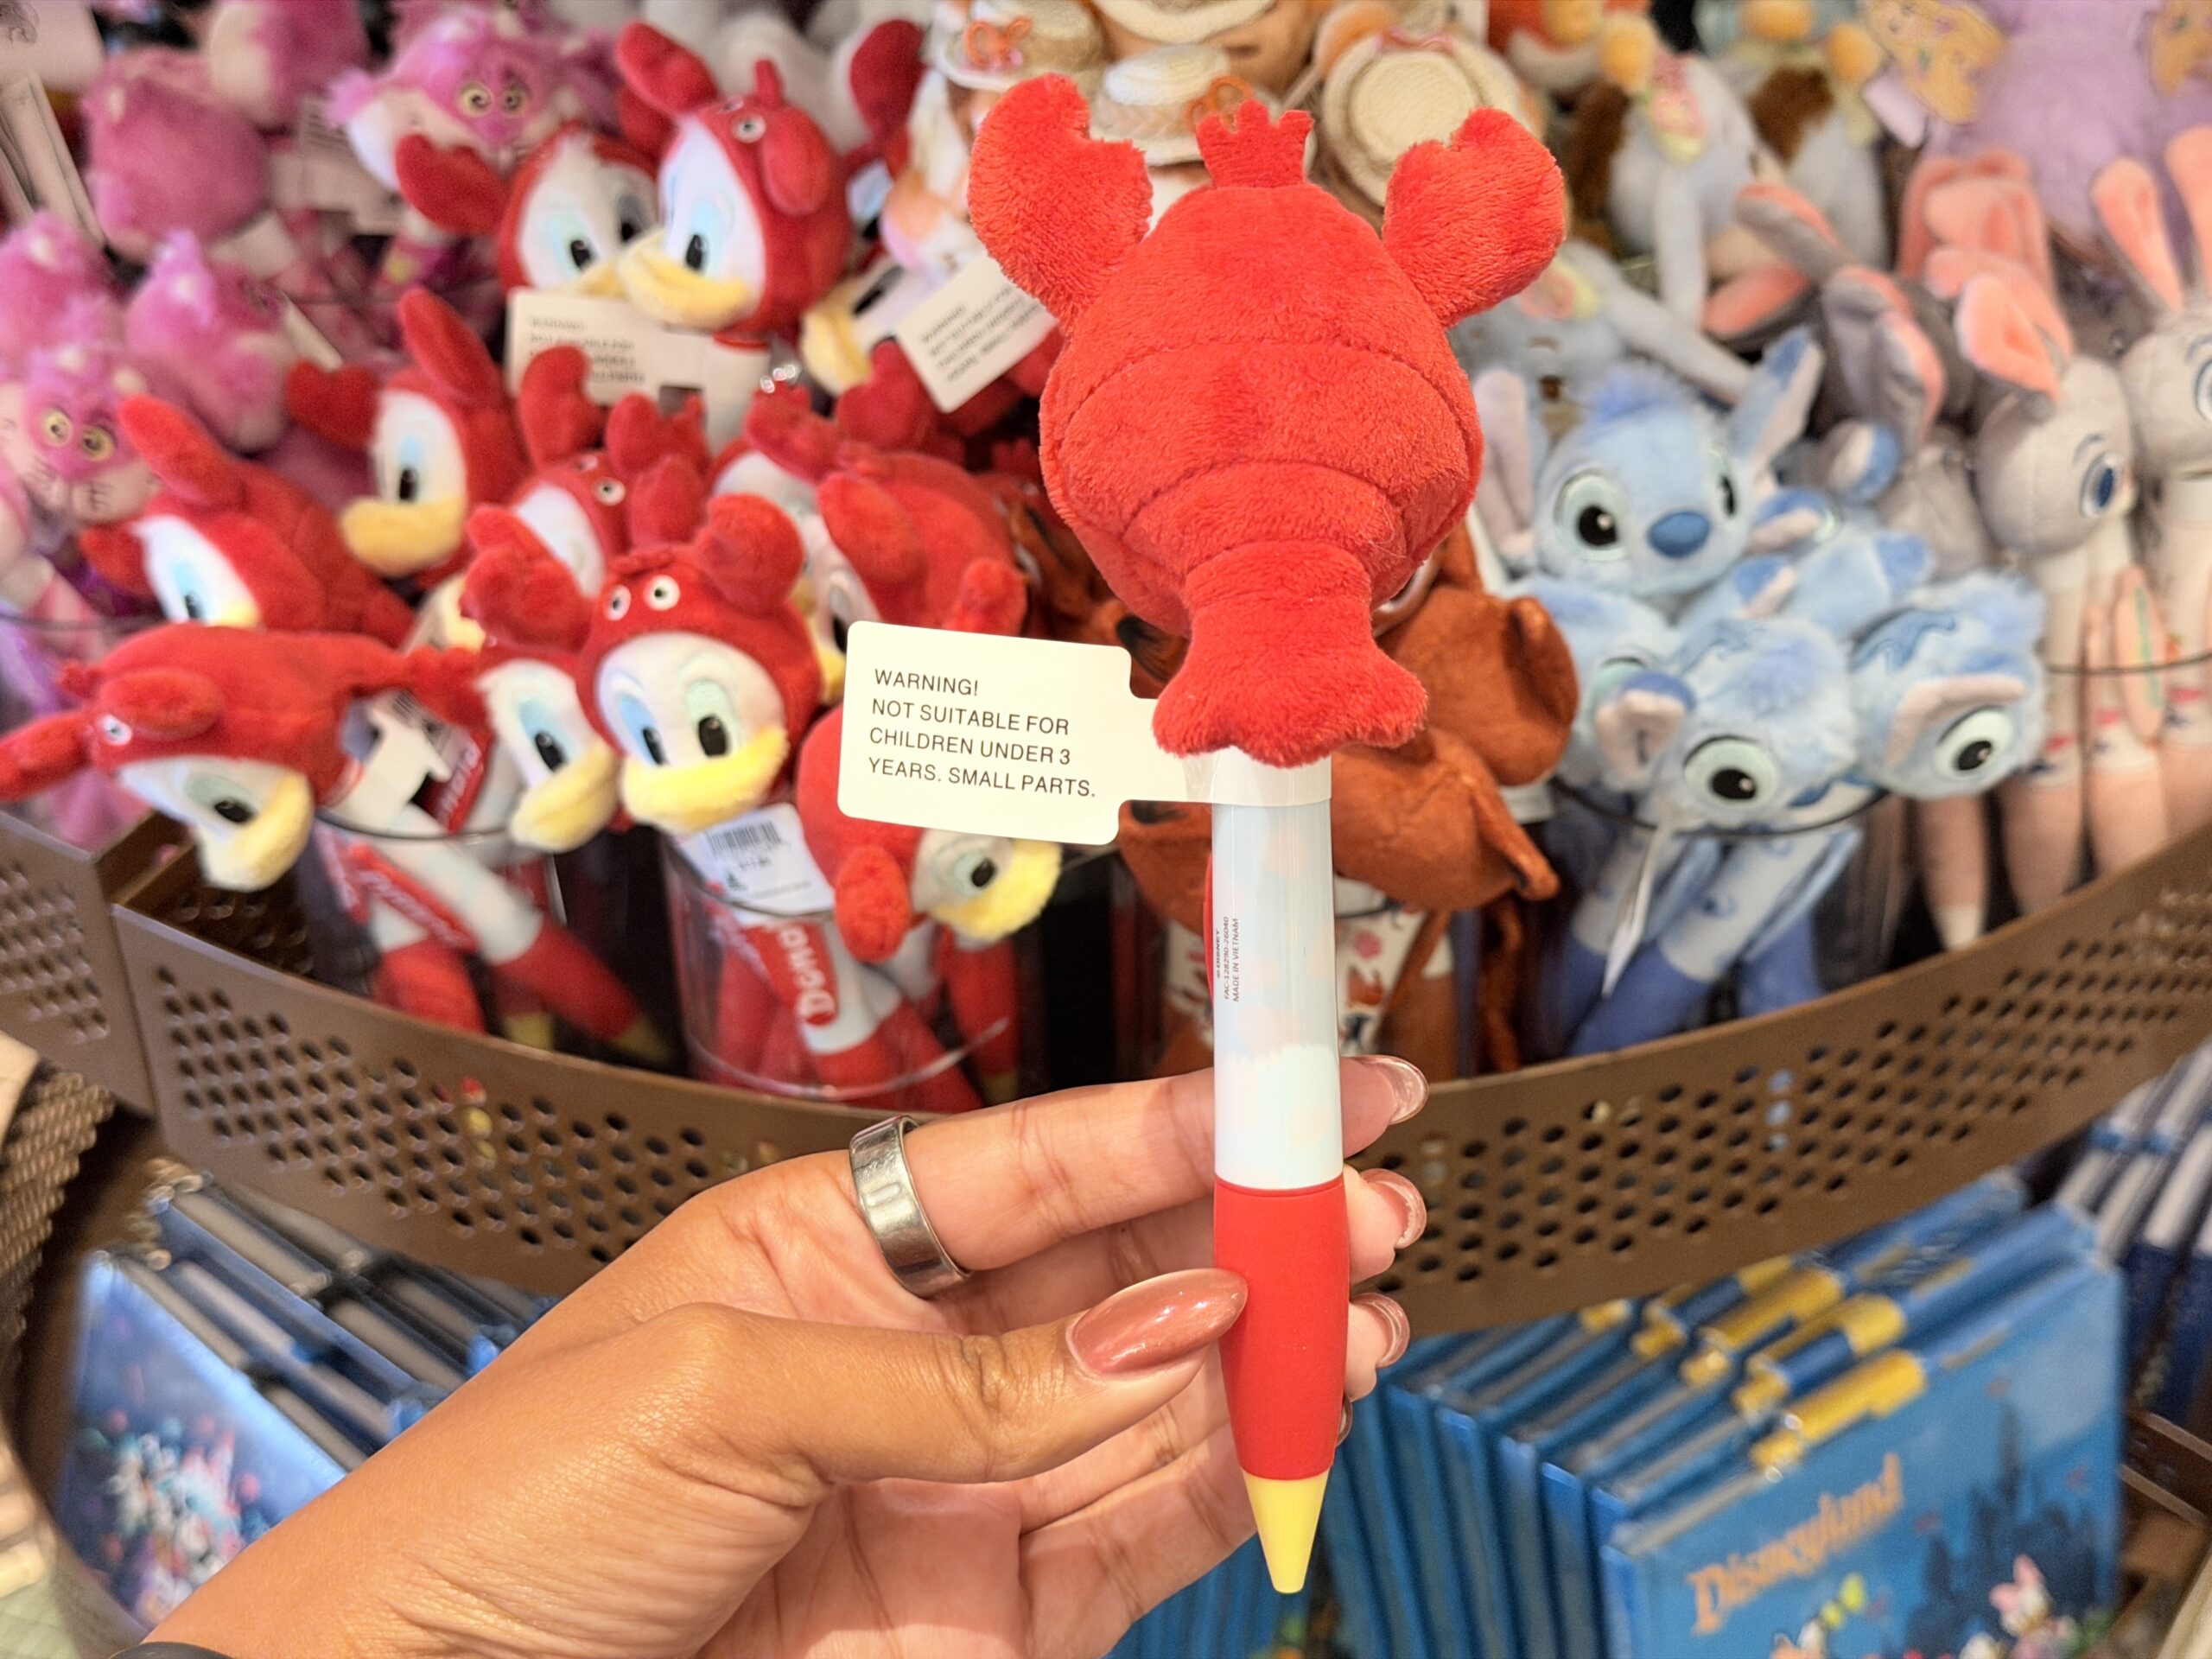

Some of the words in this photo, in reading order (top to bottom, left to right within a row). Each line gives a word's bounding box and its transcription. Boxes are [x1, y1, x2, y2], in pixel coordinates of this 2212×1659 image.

[874, 669, 979, 696] WARNING!
[872, 698, 914, 719] NOT
[919, 704, 1020, 731] SUITABLE
[1026, 715, 1070, 735] FOR
[869, 727, 973, 754] CHILDREN
[980, 740, 1053, 764] UNDER
[1059, 748, 1071, 766] 3
[868, 756, 942, 782] YEARS.
[948, 767, 1016, 790] SMALL
[1021, 775, 1096, 798] PARTS.
[1232, 963, 1239, 972] IN
[1685, 1452, 1904, 1636] Disneyland
